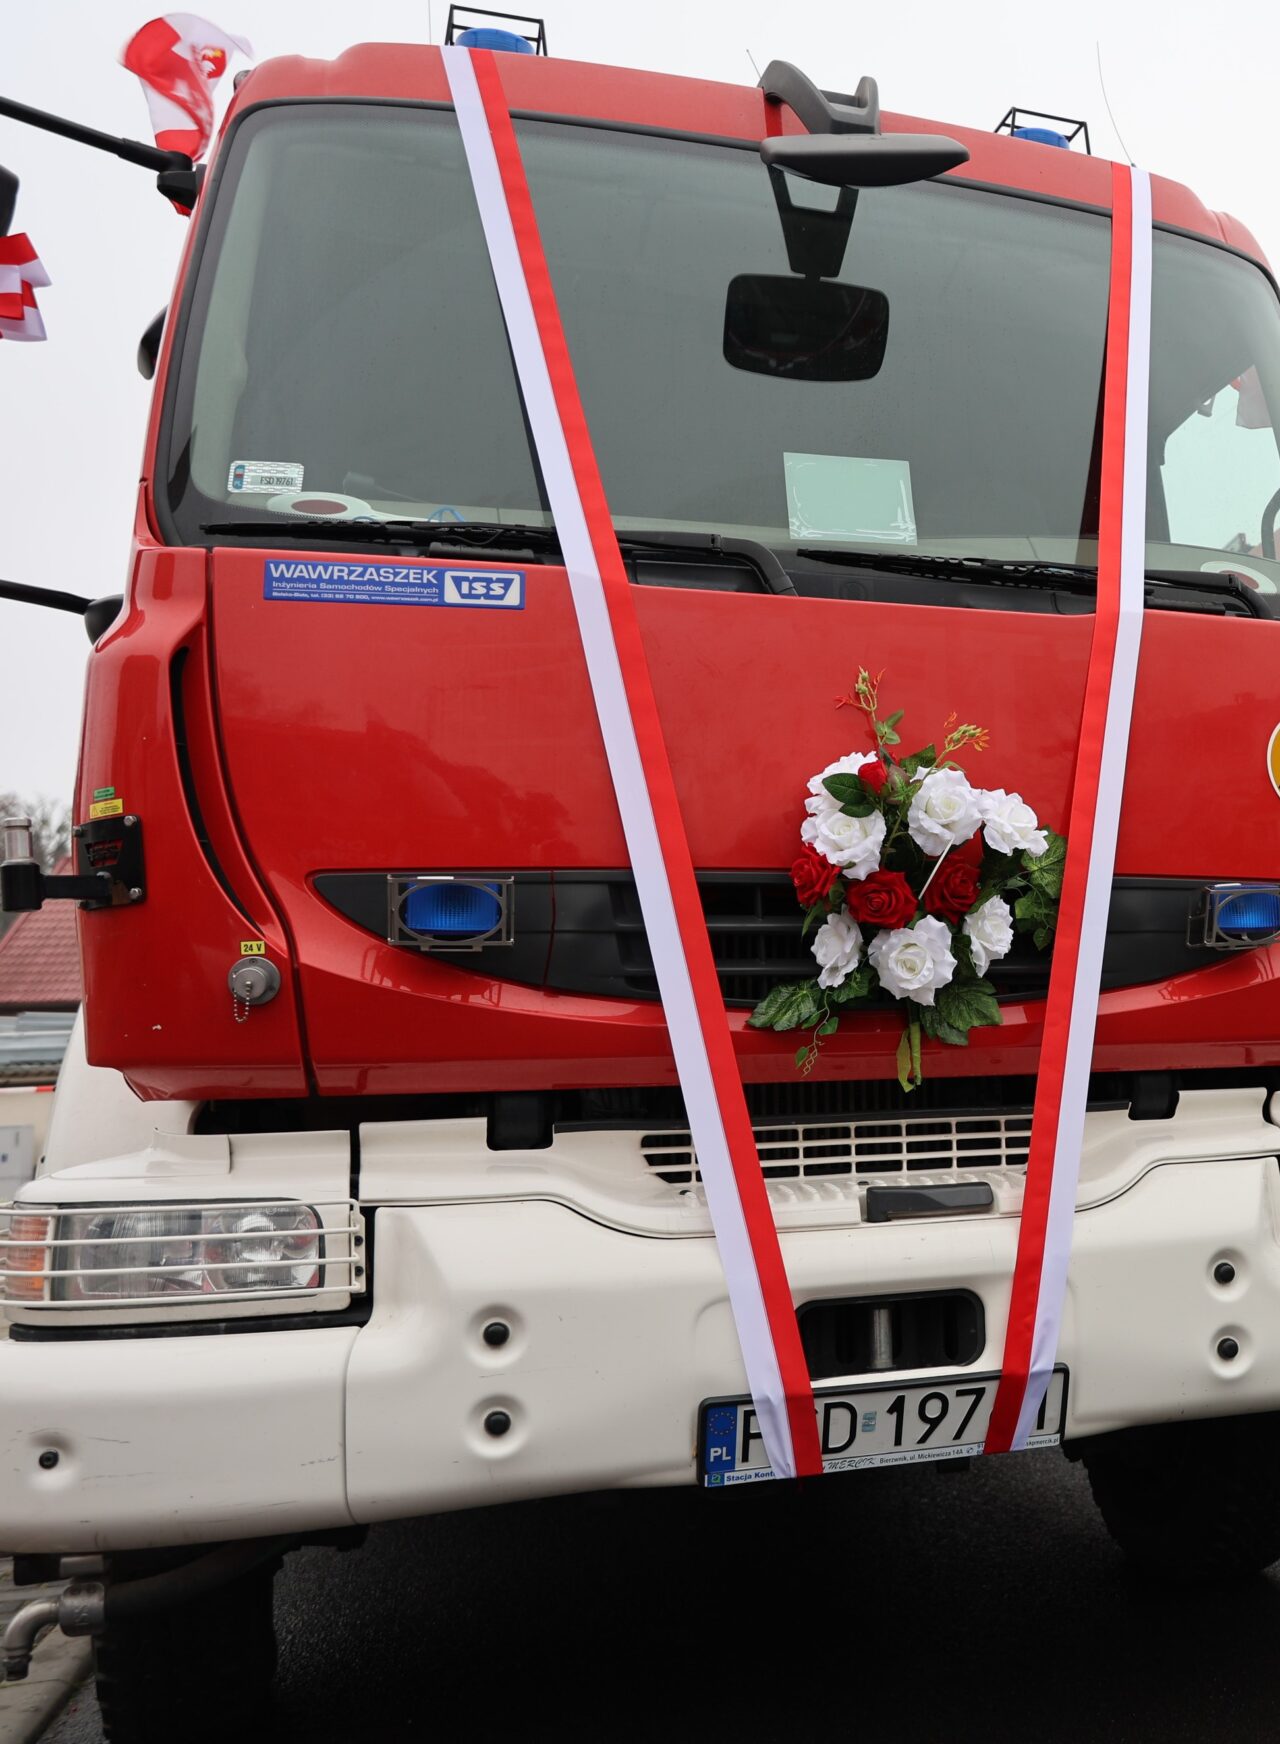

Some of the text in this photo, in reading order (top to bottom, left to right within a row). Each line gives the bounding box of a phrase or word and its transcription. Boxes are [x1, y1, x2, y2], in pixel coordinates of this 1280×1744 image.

[269, 563, 438, 584] WAWRZASZEK
[272, 580, 439, 595] Inżynieria Samochodów Specjalnych
[461, 581, 505, 596] ISS
[243, 944, 262, 953] 24 V
[709, 1446, 732, 1463] PL
[726, 1472, 752, 1483] Stacja
